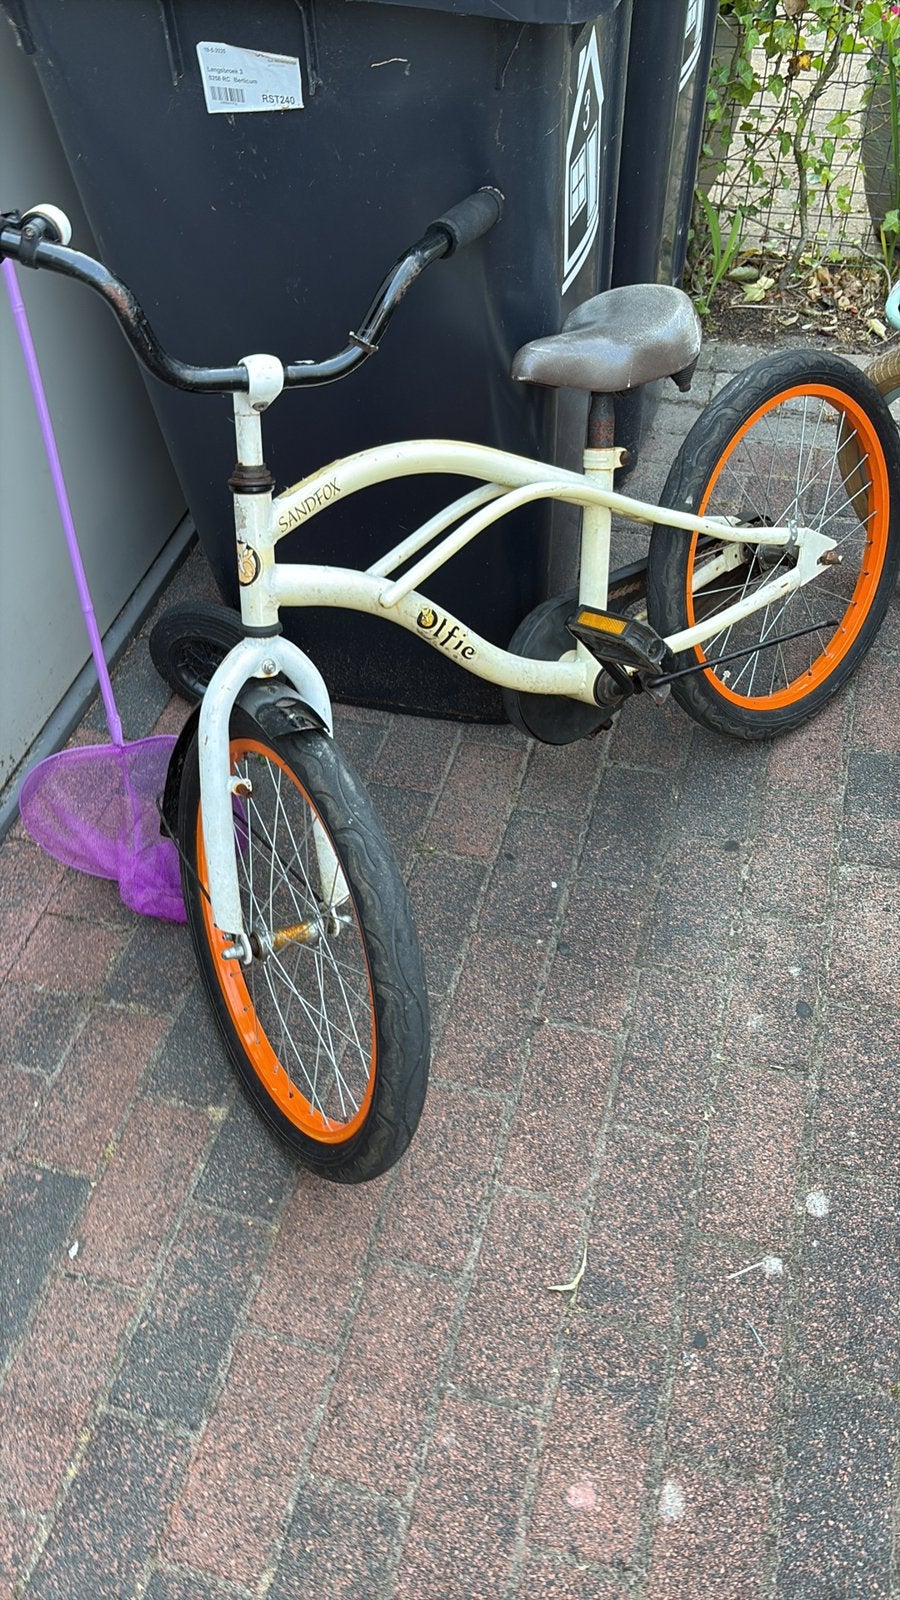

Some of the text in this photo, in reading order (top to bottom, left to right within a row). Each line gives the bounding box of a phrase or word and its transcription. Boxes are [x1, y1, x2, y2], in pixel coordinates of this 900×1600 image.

[262, 94, 295, 105] RST240
[583, 89, 590, 131] 3
[278, 477, 341, 533] SANDFOX
[416, 607, 477, 660] Olfie
